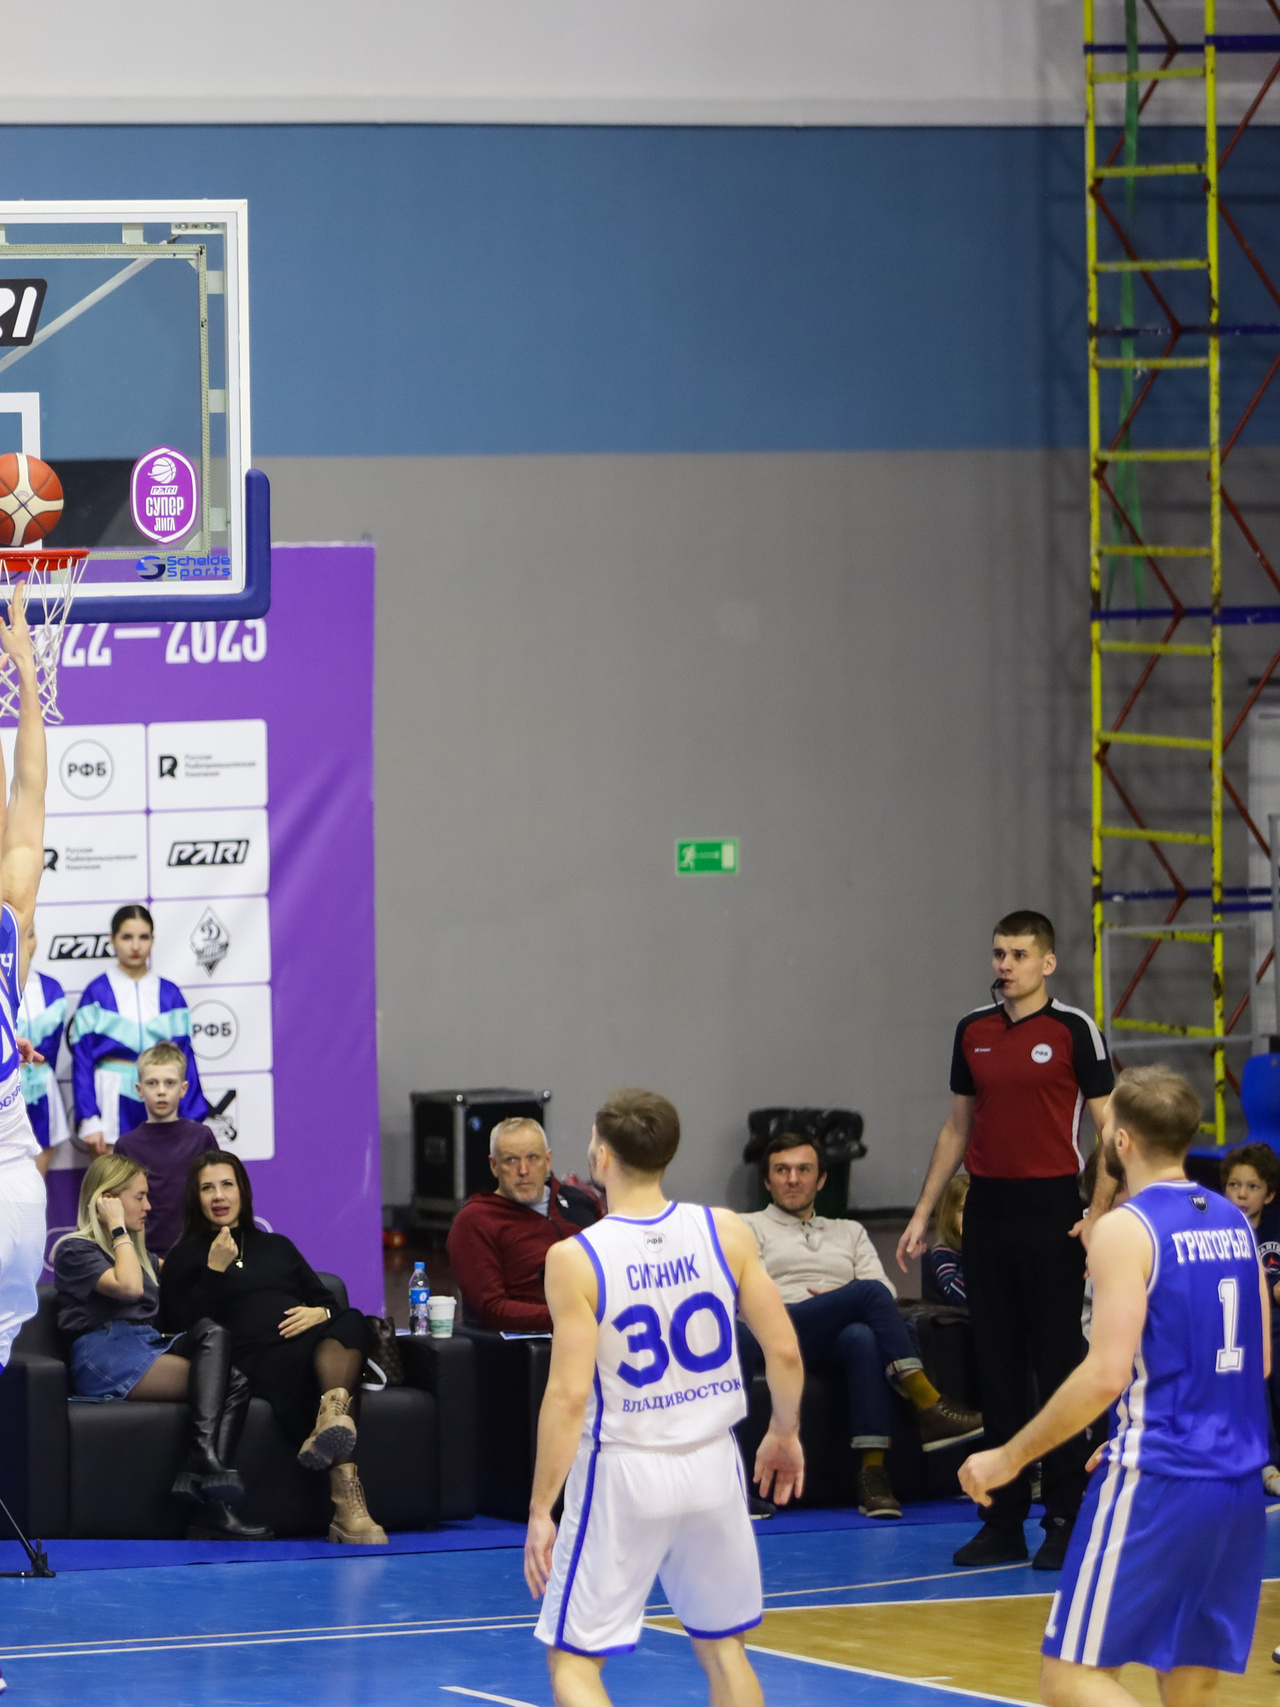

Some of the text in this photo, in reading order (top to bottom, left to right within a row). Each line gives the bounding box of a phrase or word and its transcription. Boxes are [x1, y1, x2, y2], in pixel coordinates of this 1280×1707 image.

[145, 496, 184, 517] СУПЕР
[153, 517, 176, 532] ЛИГА
[167, 555, 231, 567] Schelde
[167, 567, 231, 580] Sports
[67, 762, 107, 779] РФБ
[169, 842, 248, 866] PARI
[51, 936, 120, 959] PAR
[192, 1022, 232, 1037] РФБ
[626, 1253, 701, 1291] СИНИК
[1215, 1278, 1245, 1373] 1
[611, 1291, 732, 1388] 30
[621, 1377, 742, 1413] ВЛАДИВОСТОК
